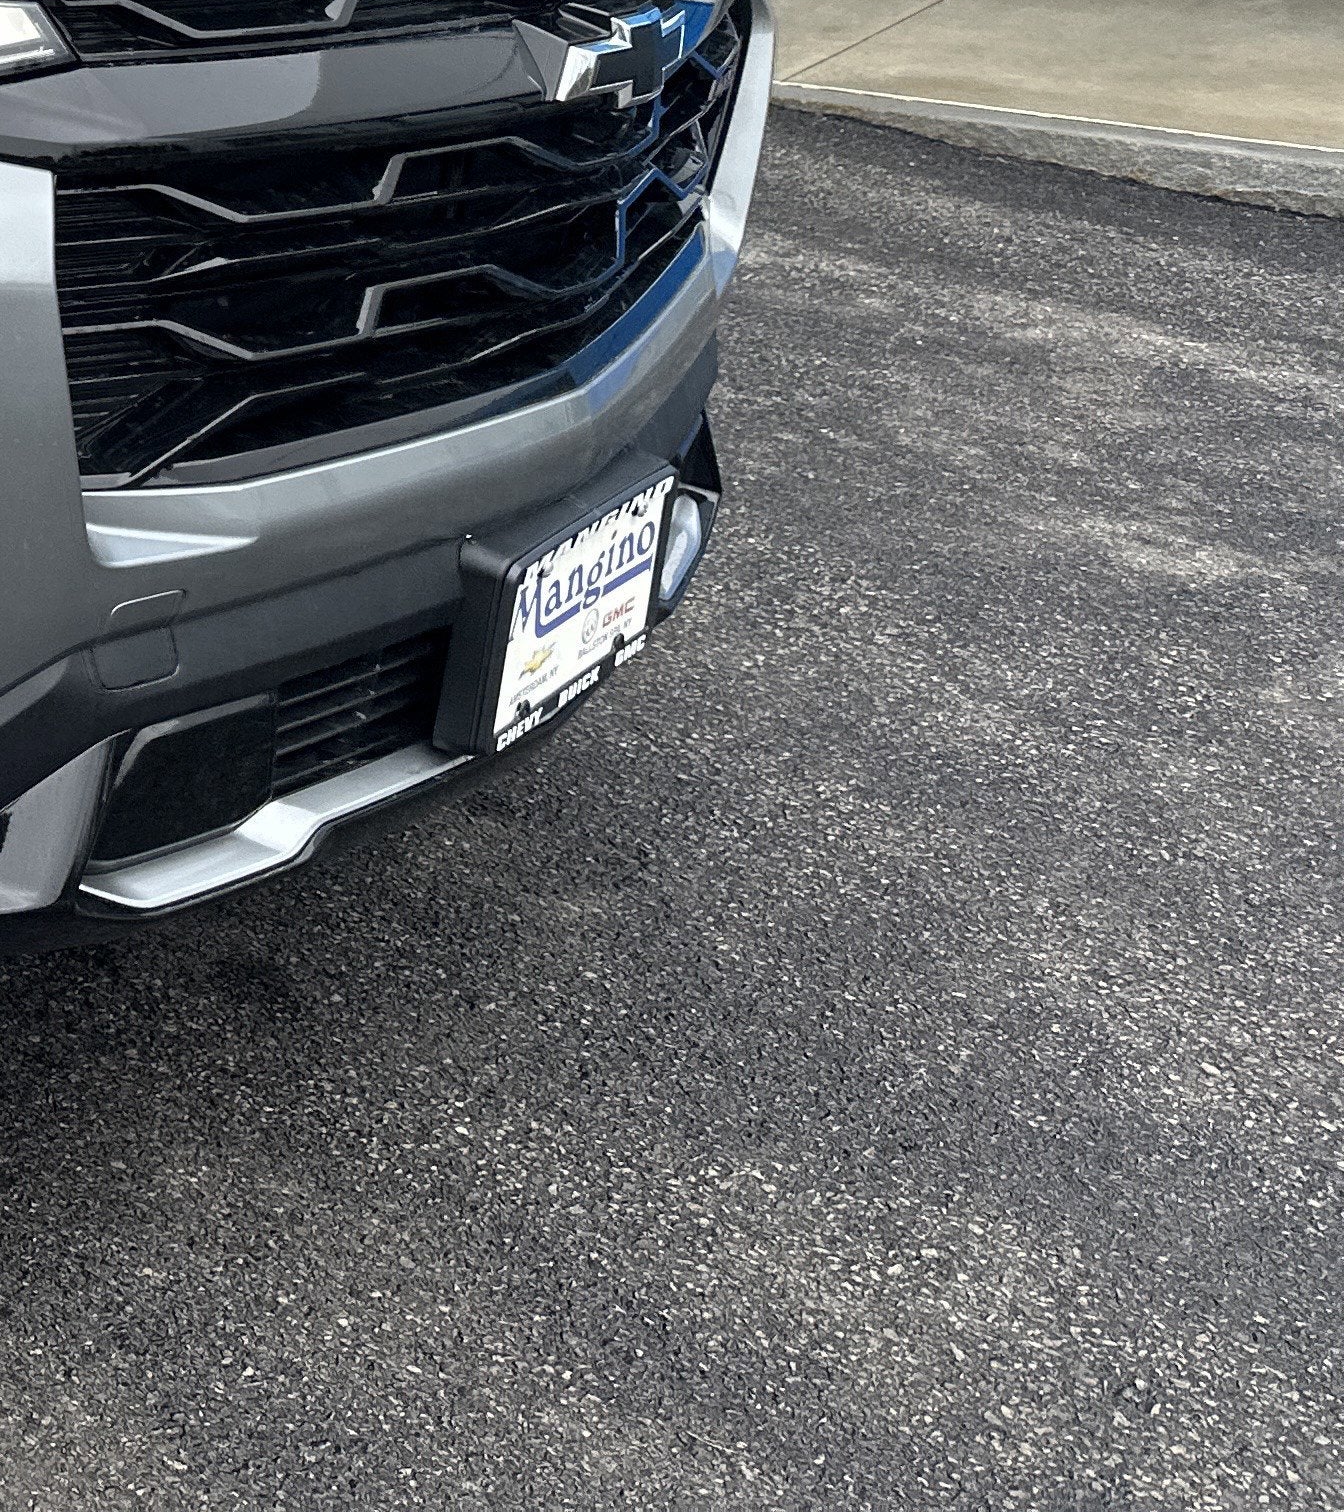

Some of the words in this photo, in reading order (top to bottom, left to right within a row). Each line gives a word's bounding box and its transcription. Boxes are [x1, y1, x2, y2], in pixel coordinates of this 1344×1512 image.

[509, 520, 656, 641] Mangino
[601, 596, 636, 629] GMC
[495, 706, 544, 753] CHEVY
[557, 665, 602, 709] BUICK
[614, 634, 648, 668] GMC
